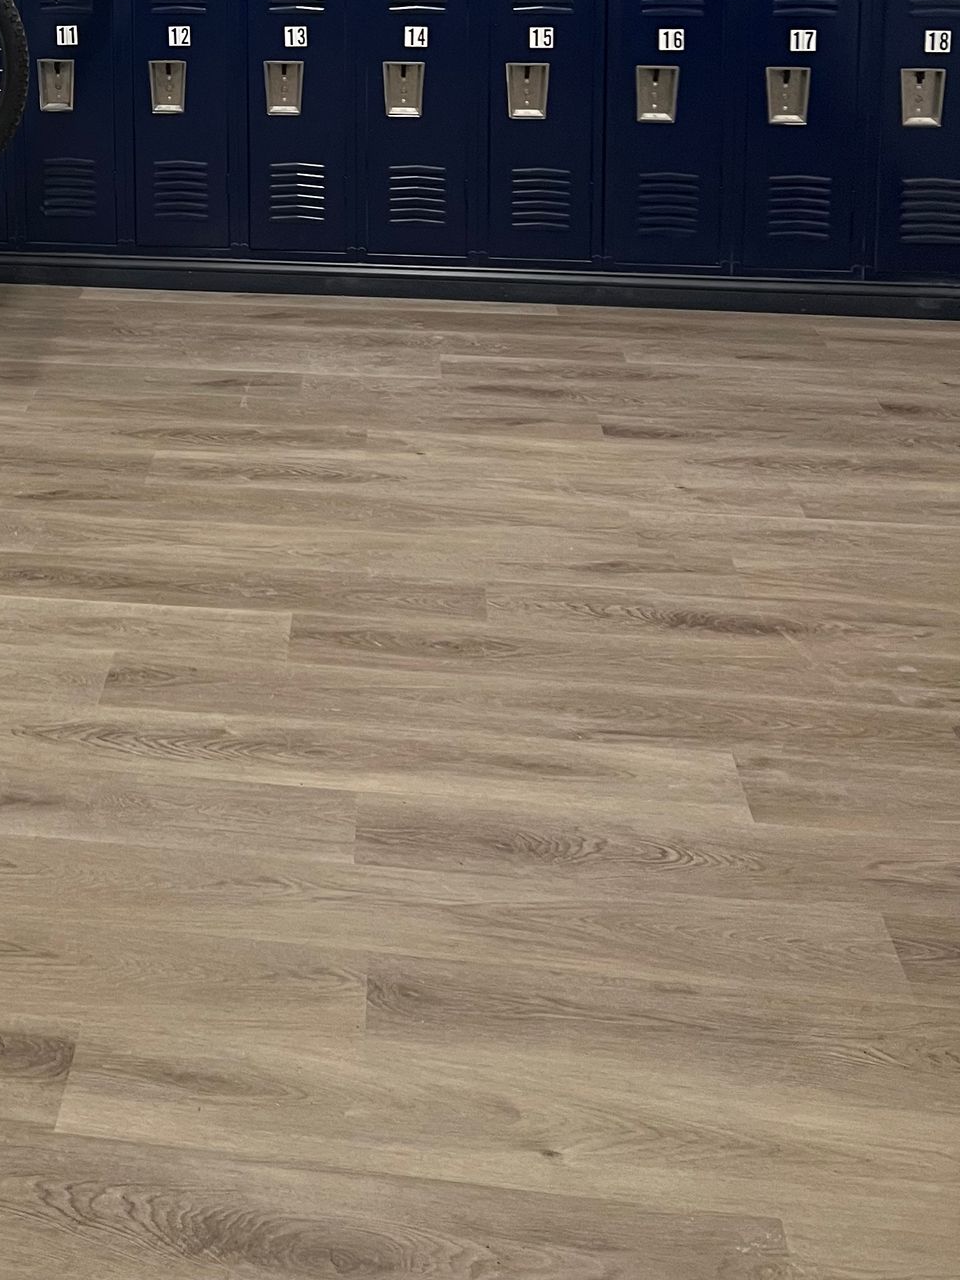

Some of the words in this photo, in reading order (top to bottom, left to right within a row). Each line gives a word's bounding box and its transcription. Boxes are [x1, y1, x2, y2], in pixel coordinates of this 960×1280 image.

[58, 26, 75, 44] 11
[171, 27, 189, 45] 12
[287, 27, 306, 46] 13
[408, 28, 426, 46] 14
[532, 28, 552, 47] 15
[663, 31, 683, 49] 16
[793, 31, 814, 50] 17
[929, 32, 949, 51] 18
